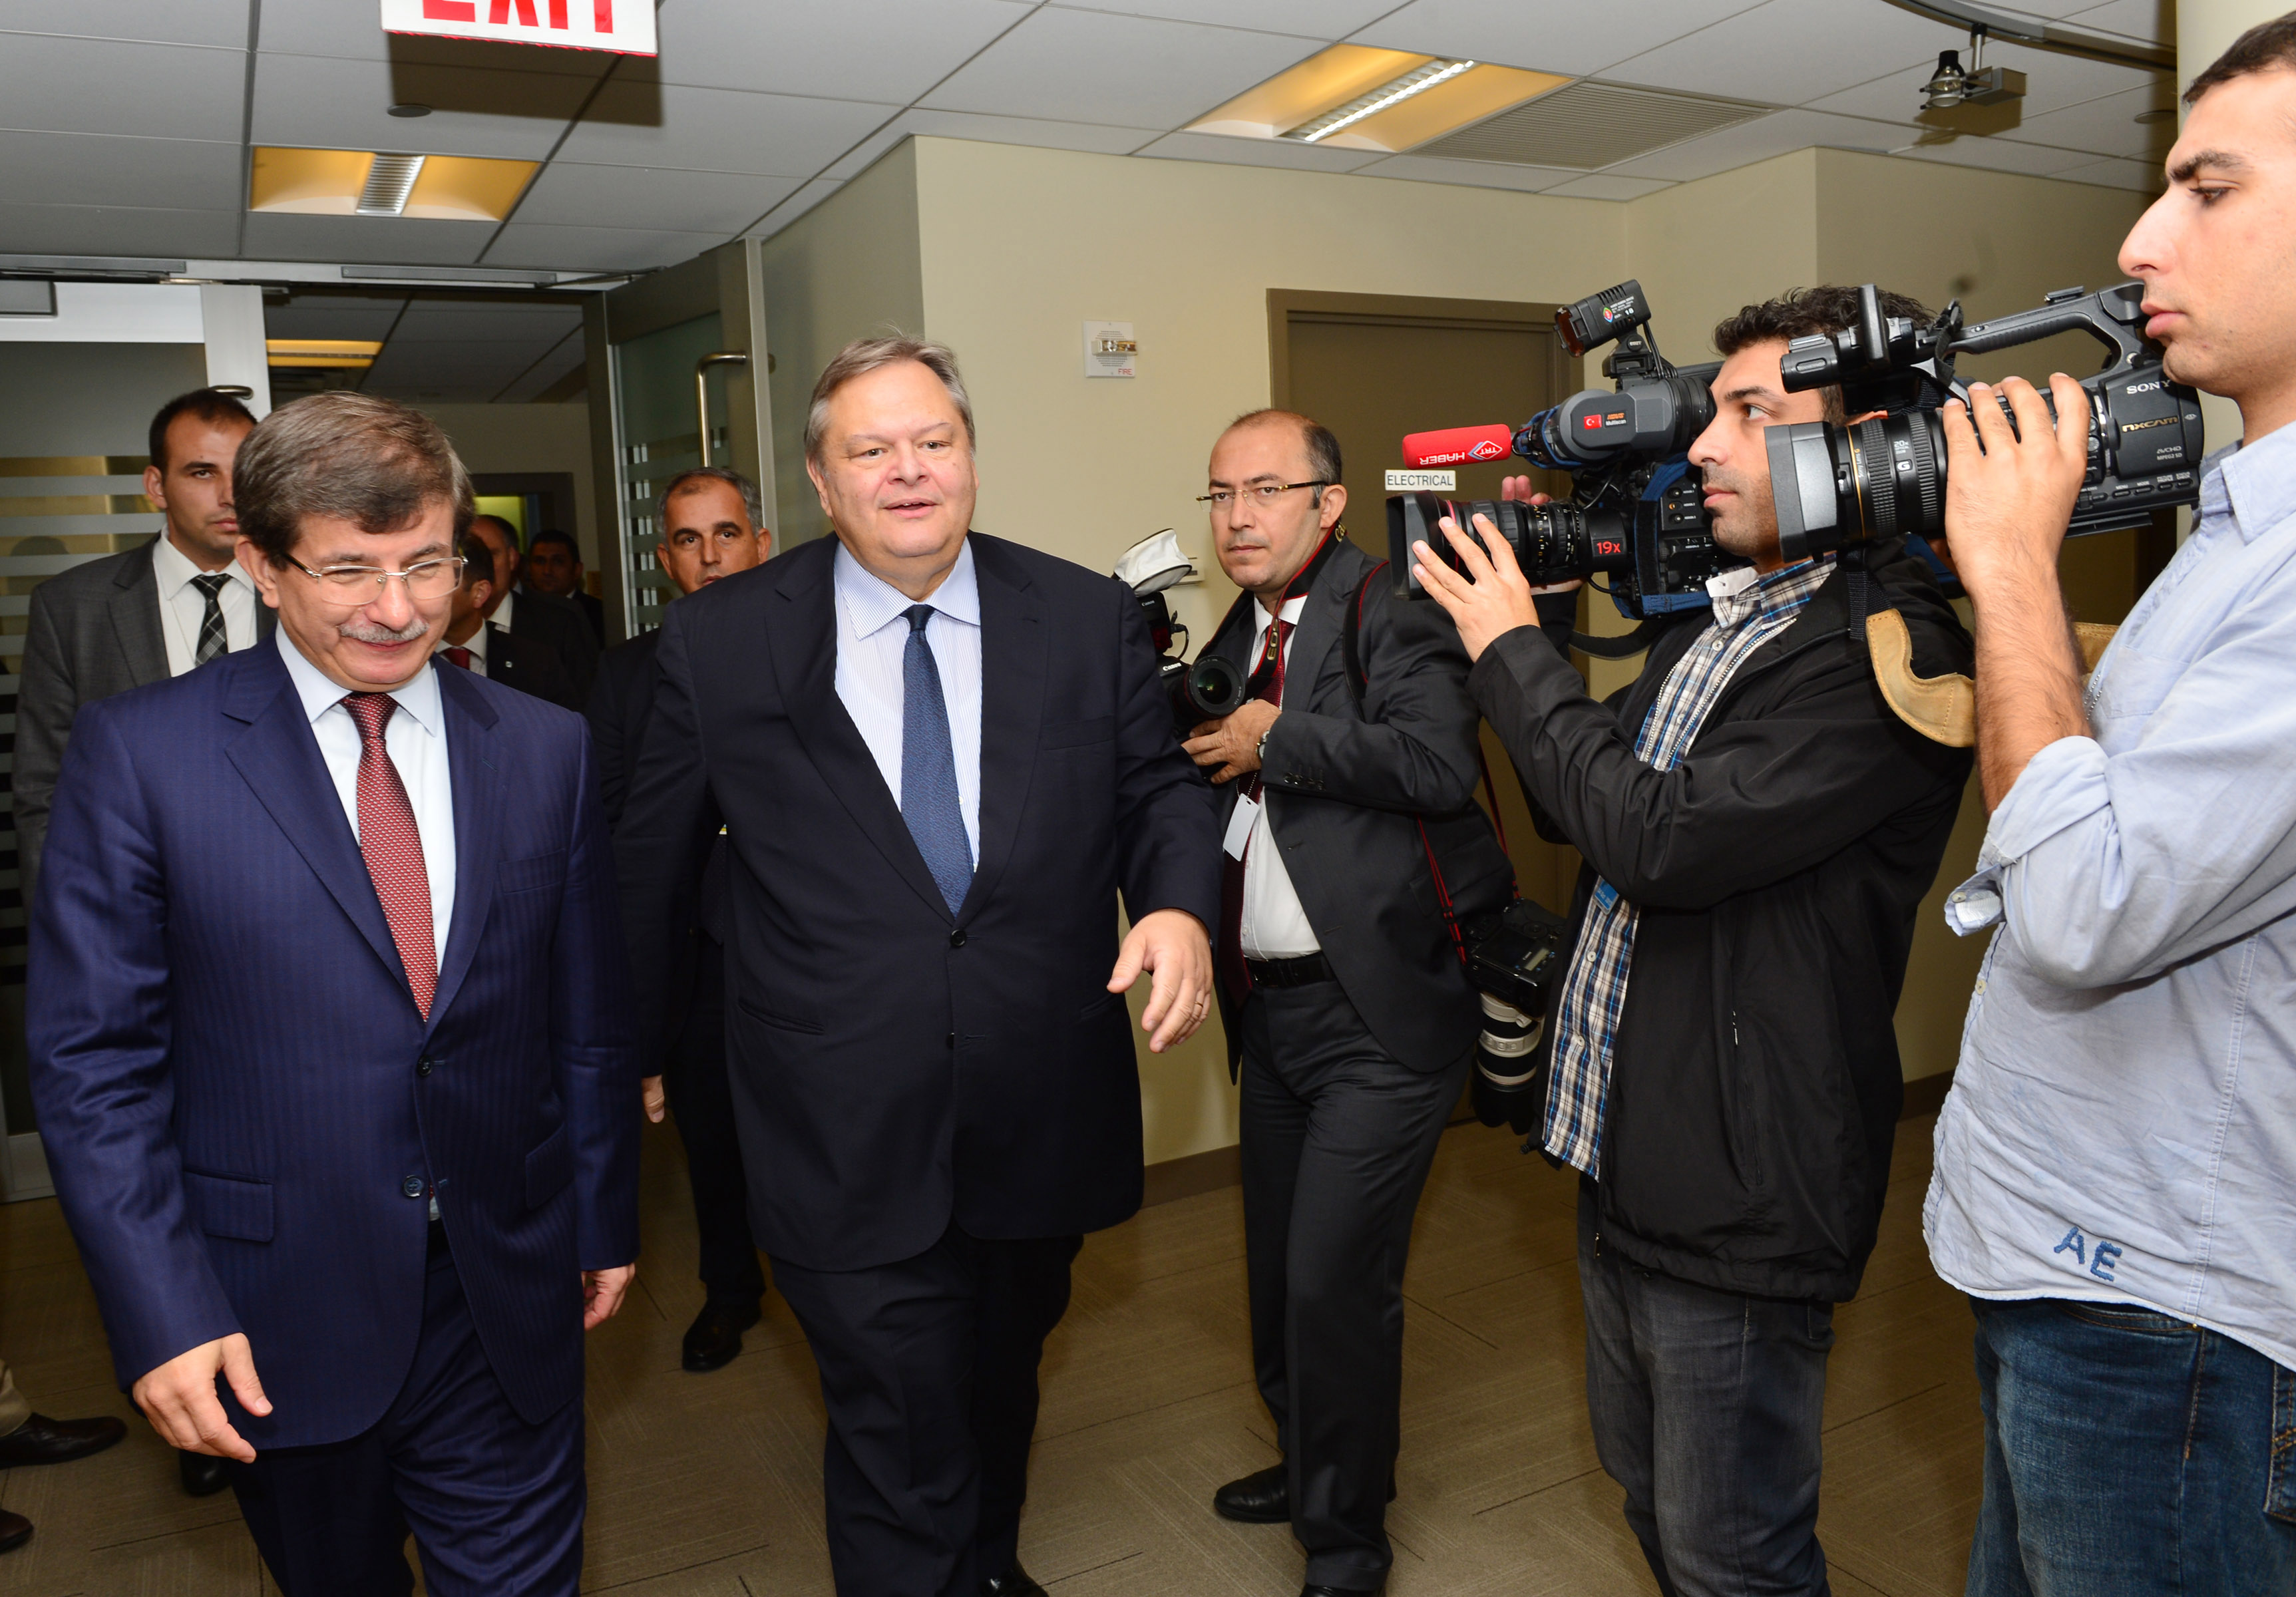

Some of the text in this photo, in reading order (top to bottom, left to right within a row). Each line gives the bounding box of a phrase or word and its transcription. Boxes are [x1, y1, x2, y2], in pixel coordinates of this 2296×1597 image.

[2126, 380, 2171, 395] SONY
[1479, 446, 1497, 455] TRT
[1420, 451, 1465, 464] HABER
[1897, 460, 1911, 471] G
[1387, 474, 1453, 486] ELECTRICAL
[1597, 541, 1621, 554] 19x
[1163, 662, 1182, 671] Canon
[2054, 1226, 2122, 1282] AE
